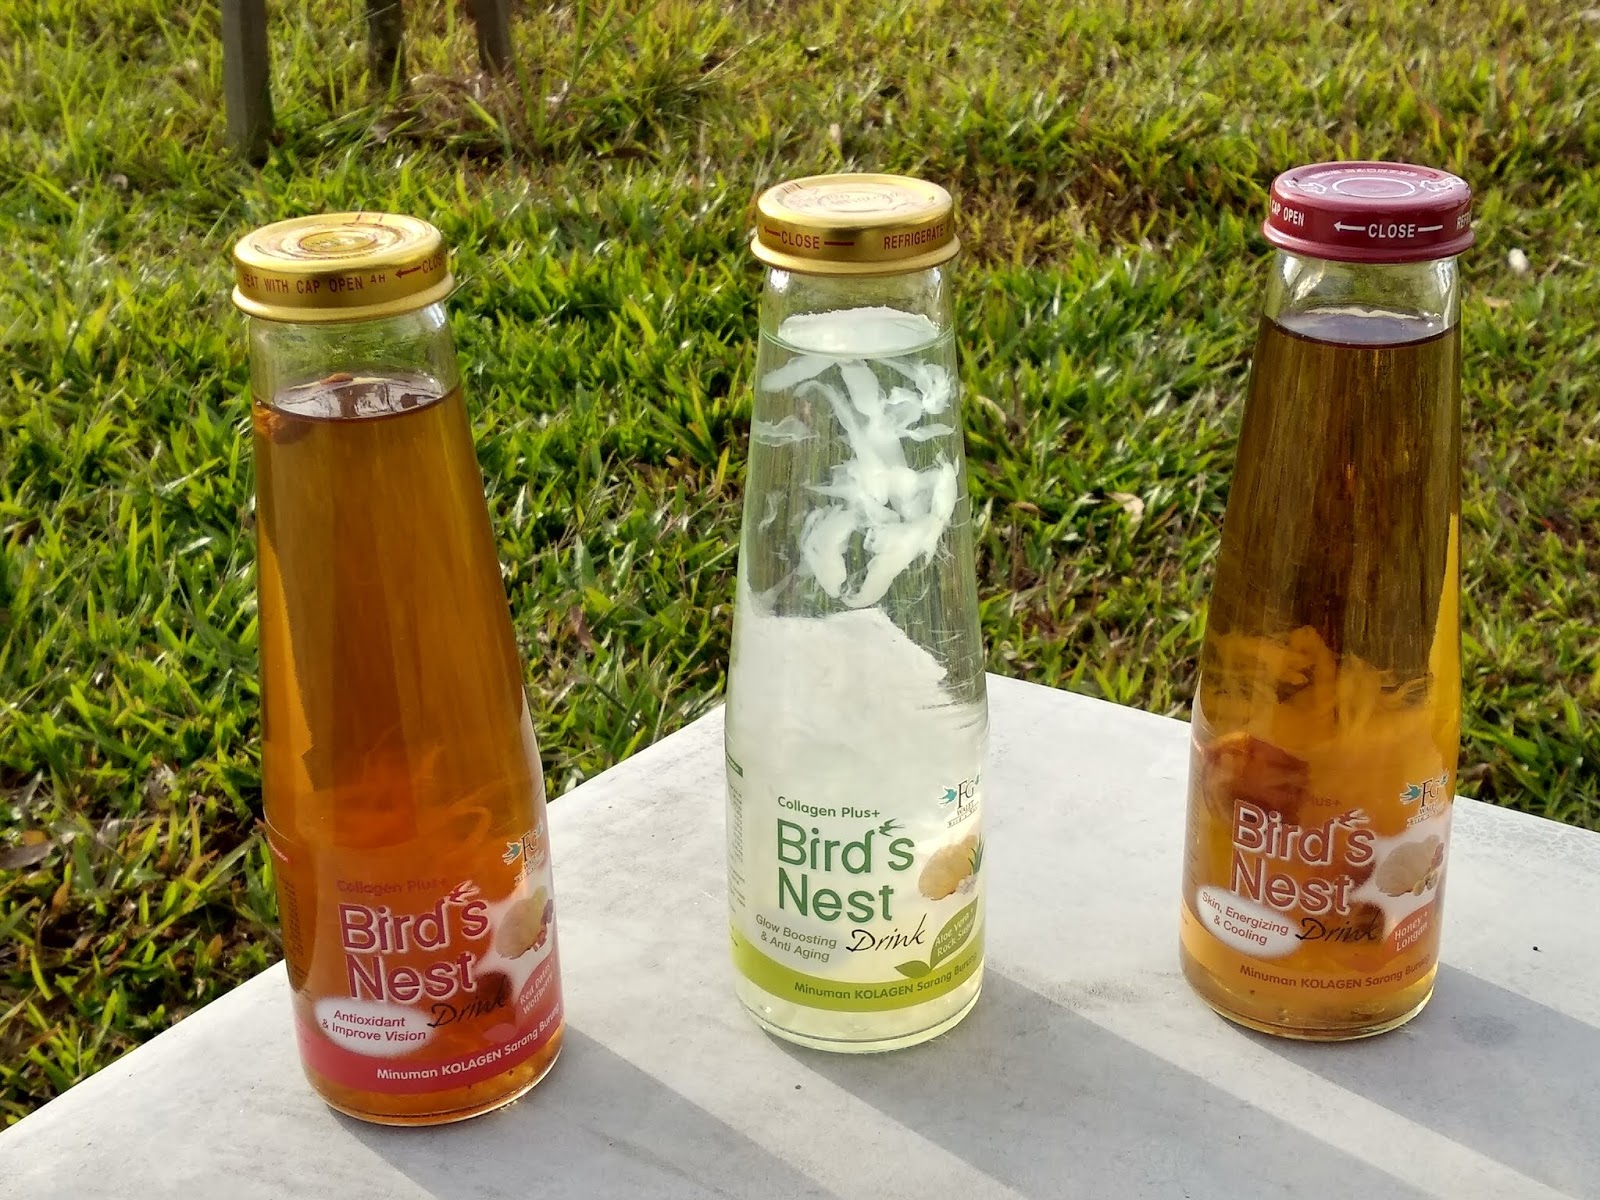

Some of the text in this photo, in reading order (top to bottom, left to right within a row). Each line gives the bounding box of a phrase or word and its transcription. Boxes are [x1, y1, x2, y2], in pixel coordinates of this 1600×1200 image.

[1283, 206, 1305, 227] OPEN
[1368, 223, 1416, 239] CLOSE
[781, 230, 820, 250] CLOSE
[884, 224, 944, 250] REFRIGERATE
[264, 278, 289, 293] WITH
[296, 279, 320, 294] CAP
[329, 276, 363, 293] OPEN
[778, 796, 880, 819] Collagen Plus+
[777, 818, 915, 875] Bird's
[1233, 799, 1375, 866] Bird's
[778, 867, 894, 923] Nest
[1231, 849, 1355, 915] Nest
[337, 881, 491, 952] Bird's
[1202, 891, 1289, 936] Skin, Energizing
[1295, 909, 1380, 942] Drink
[1395, 916, 1421, 940] Honey
[756, 914, 838, 950] Glow Boosting
[846, 913, 928, 952] Drink
[935, 929, 953, 947] Aloe
[1214, 916, 1268, 945] & Cooling
[761, 930, 830, 963] & Anti Aging
[345, 951, 476, 1001] Nest
[794, 982, 851, 999] Minuman
[854, 984, 914, 1000] KOLAGEN
[917, 971, 952, 991] Sarang
[1240, 963, 1297, 987] Minuman
[1300, 978, 1362, 989] KOLAGEN
[1365, 969, 1403, 987] Sarang
[321, 1018, 427, 1042] & Improve Vision
[333, 1009, 406, 1028] Antioxidant
[376, 1067, 438, 1081] Minuman
[441, 1048, 502, 1077] KOLAGEN
[504, 1028, 539, 1056] Sarang
